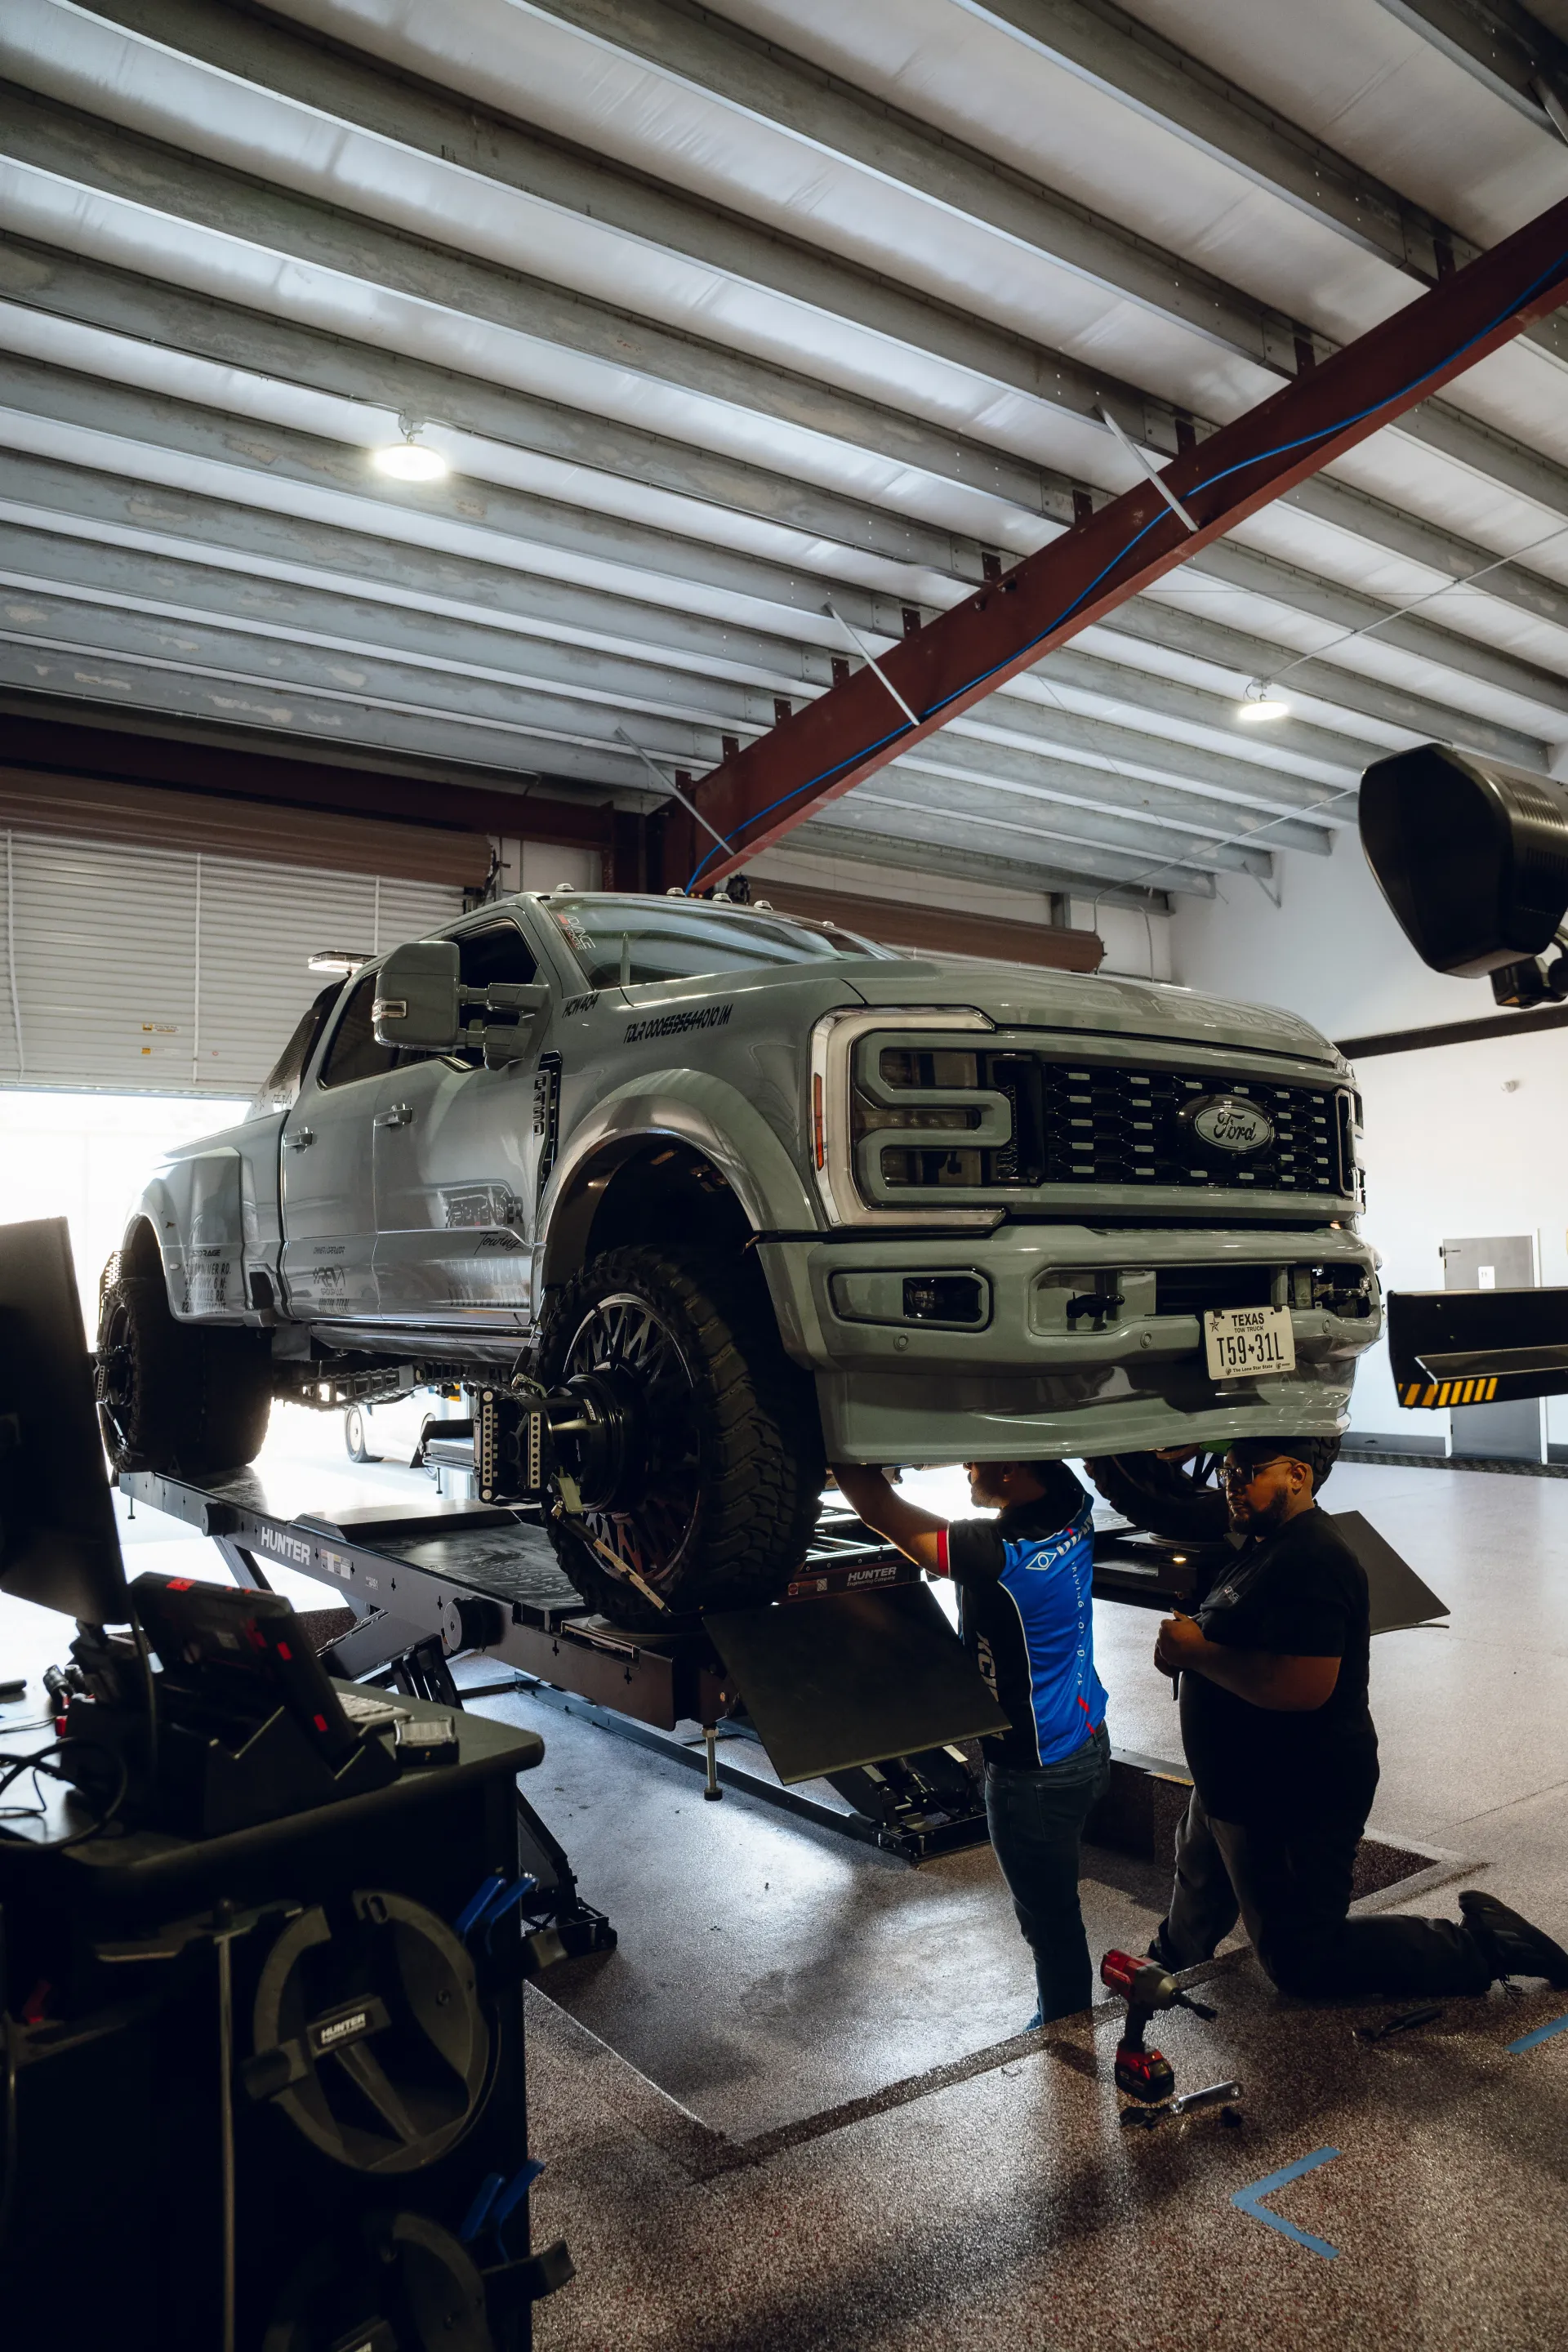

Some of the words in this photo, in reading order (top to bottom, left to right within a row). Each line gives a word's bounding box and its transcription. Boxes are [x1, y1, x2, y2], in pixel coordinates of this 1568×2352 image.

[623, 1021, 646, 1044] TDLR
[1214, 1111, 1256, 1142] Ford
[474, 1232, 523, 1255] Towing
[1232, 1312, 1264, 1326] TEXAS
[261, 1526, 311, 1566] HUNTER
[847, 1578, 874, 1587] Engineering
[874, 1575, 896, 1584] Company
[848, 1566, 897, 1582] HUNTER
[321, 2013, 366, 2038] HUNTER
